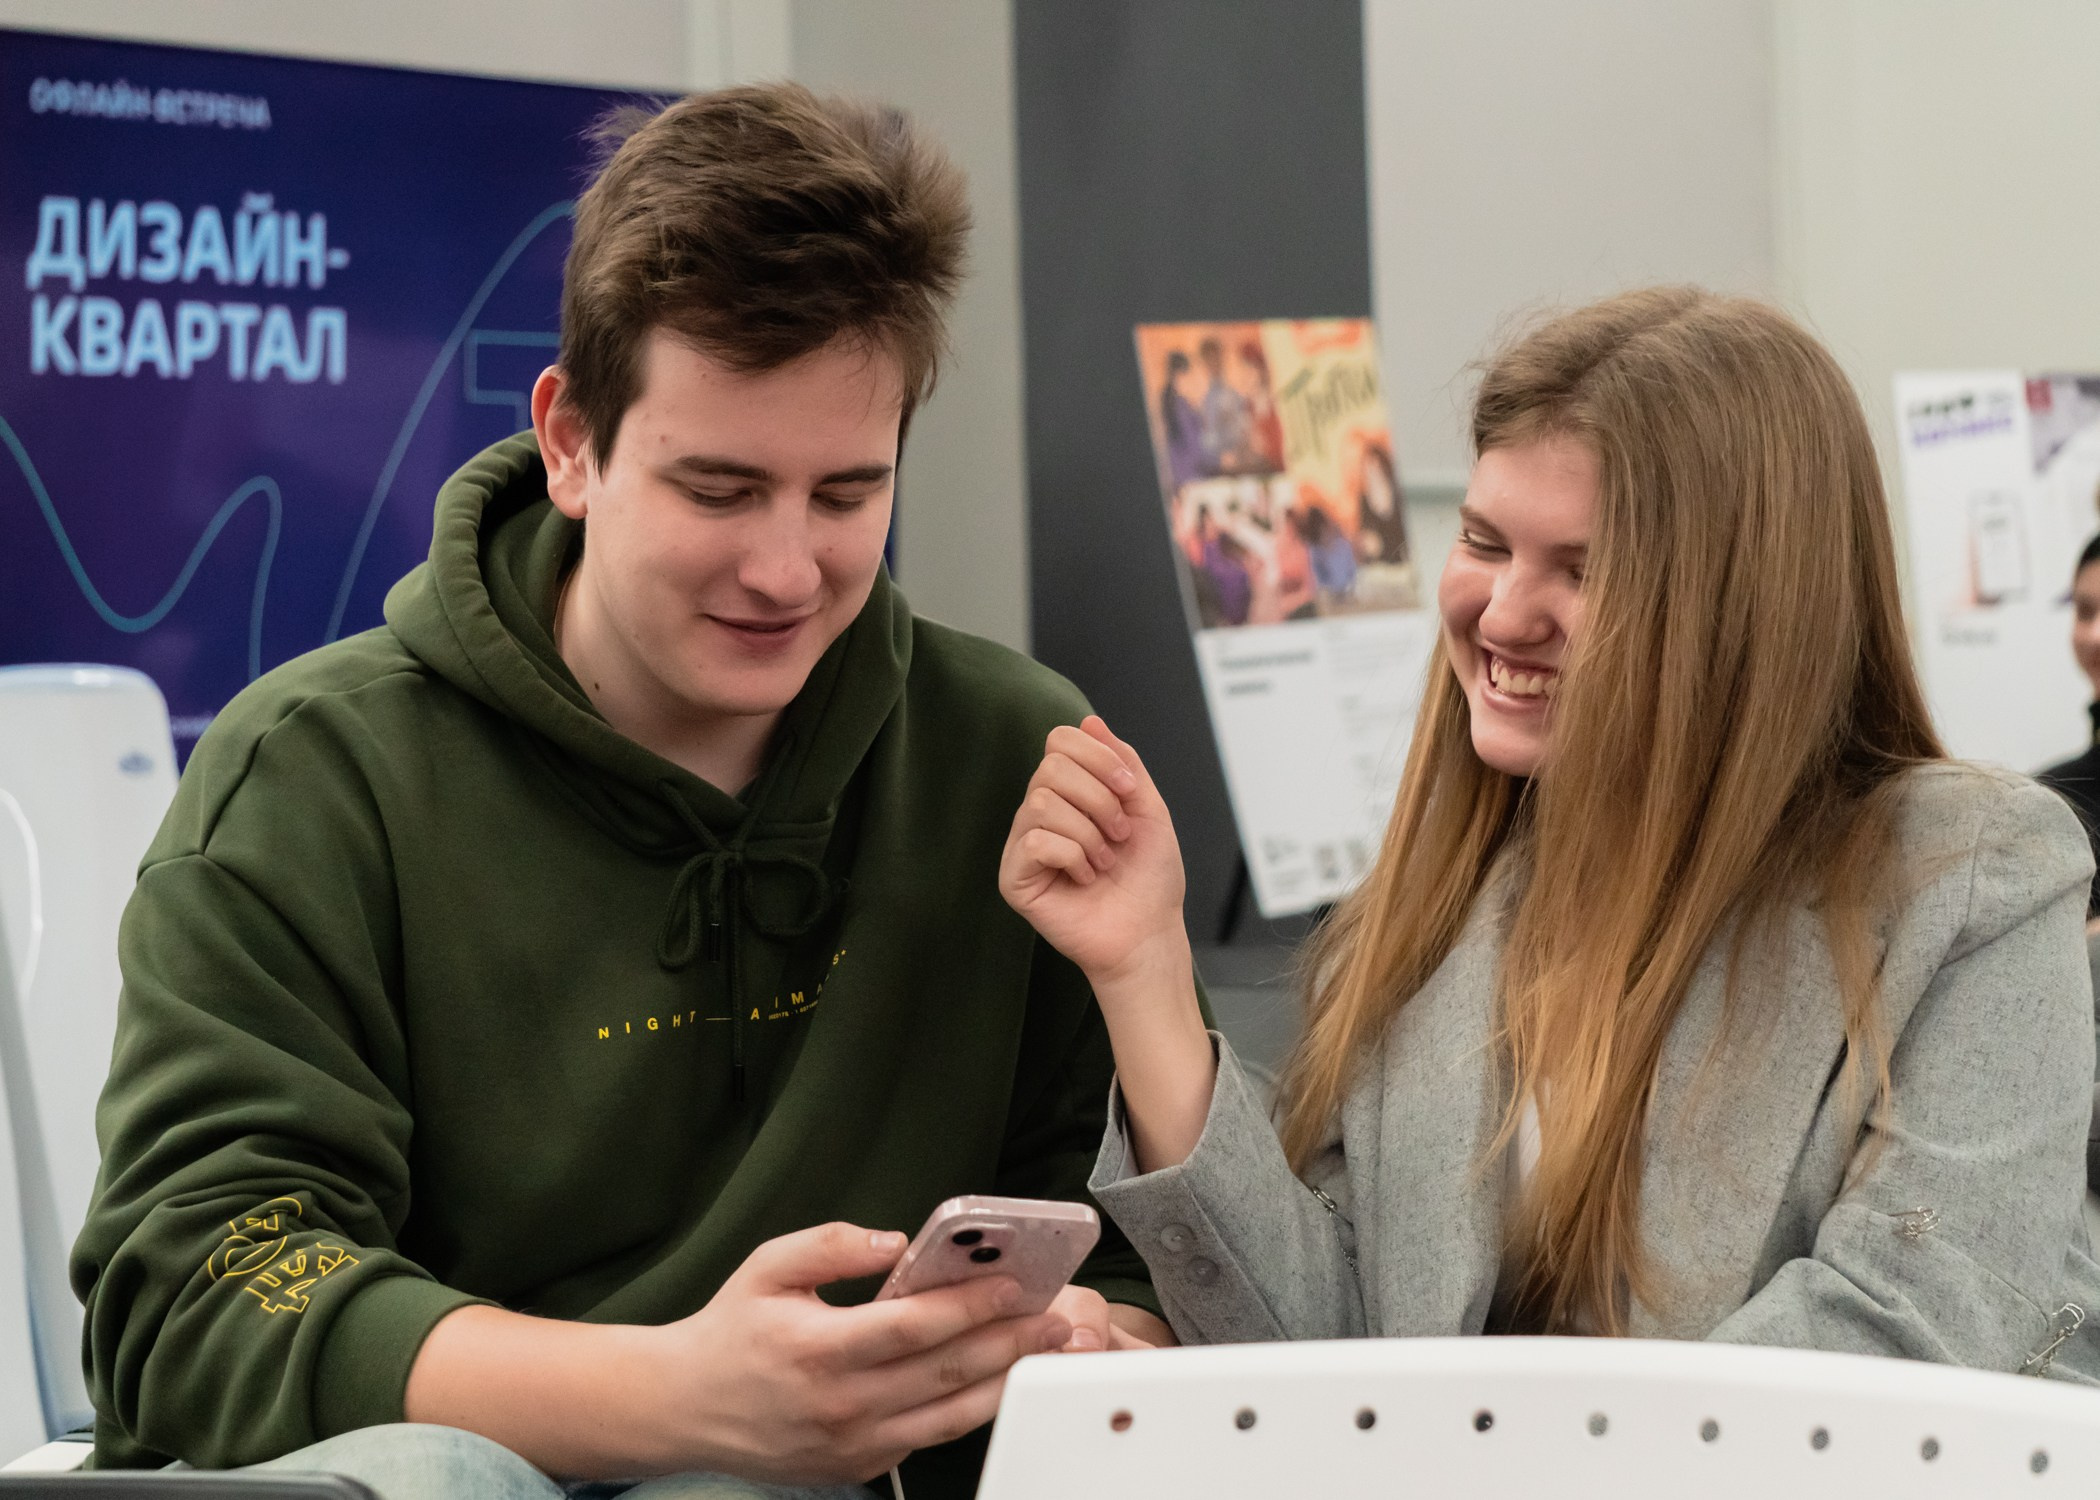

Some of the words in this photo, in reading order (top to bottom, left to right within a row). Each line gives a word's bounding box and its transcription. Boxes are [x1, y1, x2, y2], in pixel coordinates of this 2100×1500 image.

[26, 193, 350, 290] ДИЗАЙН-
[31, 295, 347, 384] КВАРТАЛ
[598, 1010, 697, 1039] NIGHT
